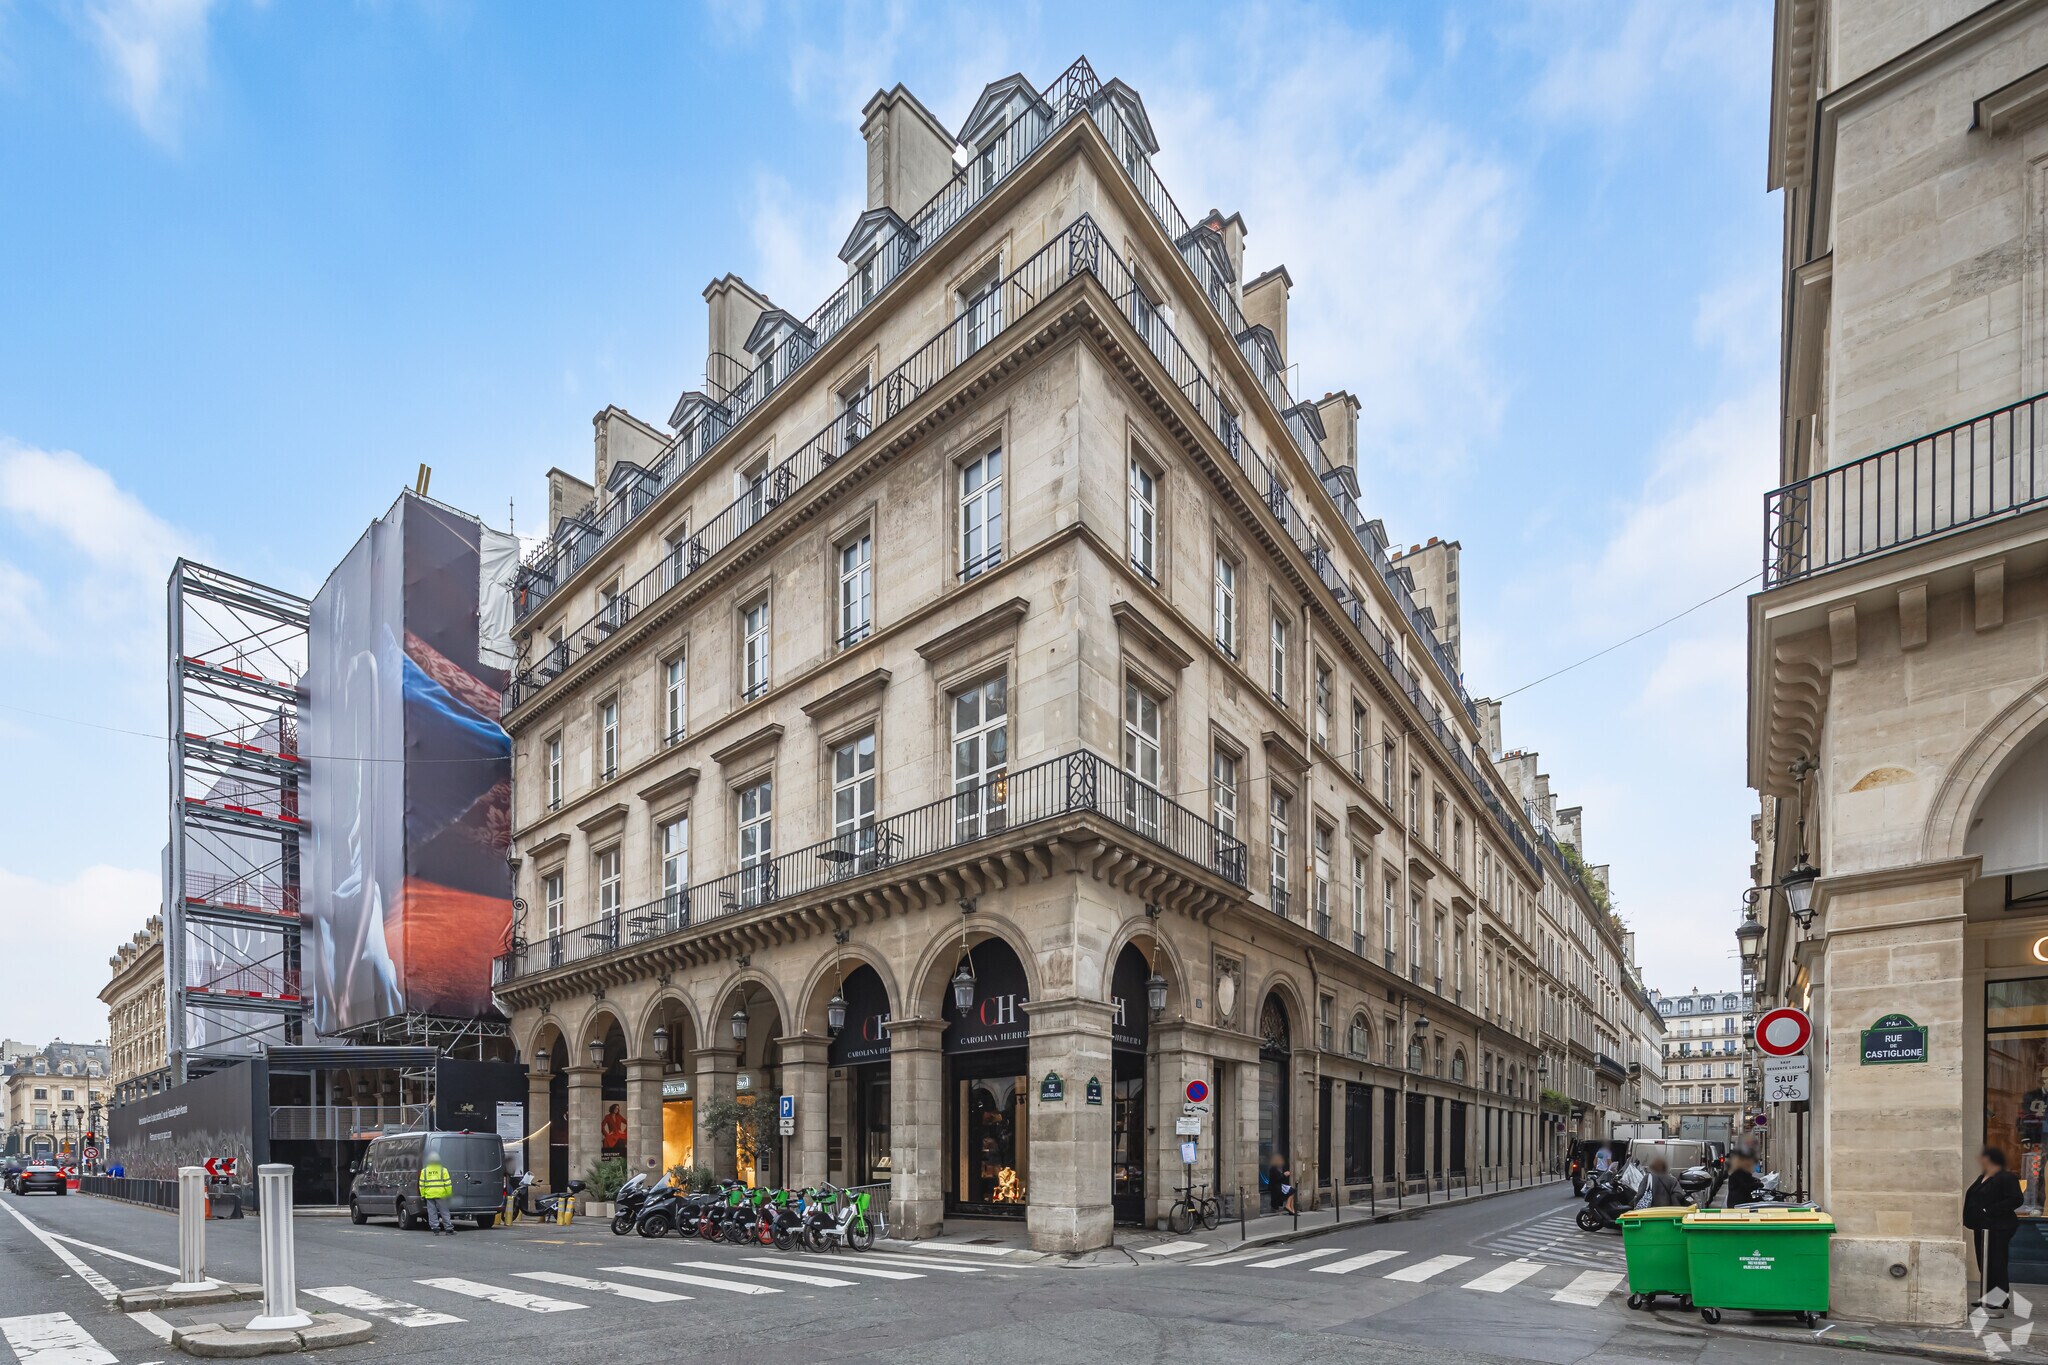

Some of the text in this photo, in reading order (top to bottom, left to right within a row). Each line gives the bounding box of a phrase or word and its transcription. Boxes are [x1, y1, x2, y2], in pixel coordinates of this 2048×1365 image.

[980, 994, 1017, 1026] CH
[960, 1034, 998, 1045] CAROLINA
[1884, 1034, 1902, 1042] RUE
[847, 1049, 878, 1058] CAROLINA
[1865, 1048, 1923, 1058] CASTIGLIONE
[1774, 1074, 1799, 1083] SAUF
[784, 1100, 790, 1114] P
